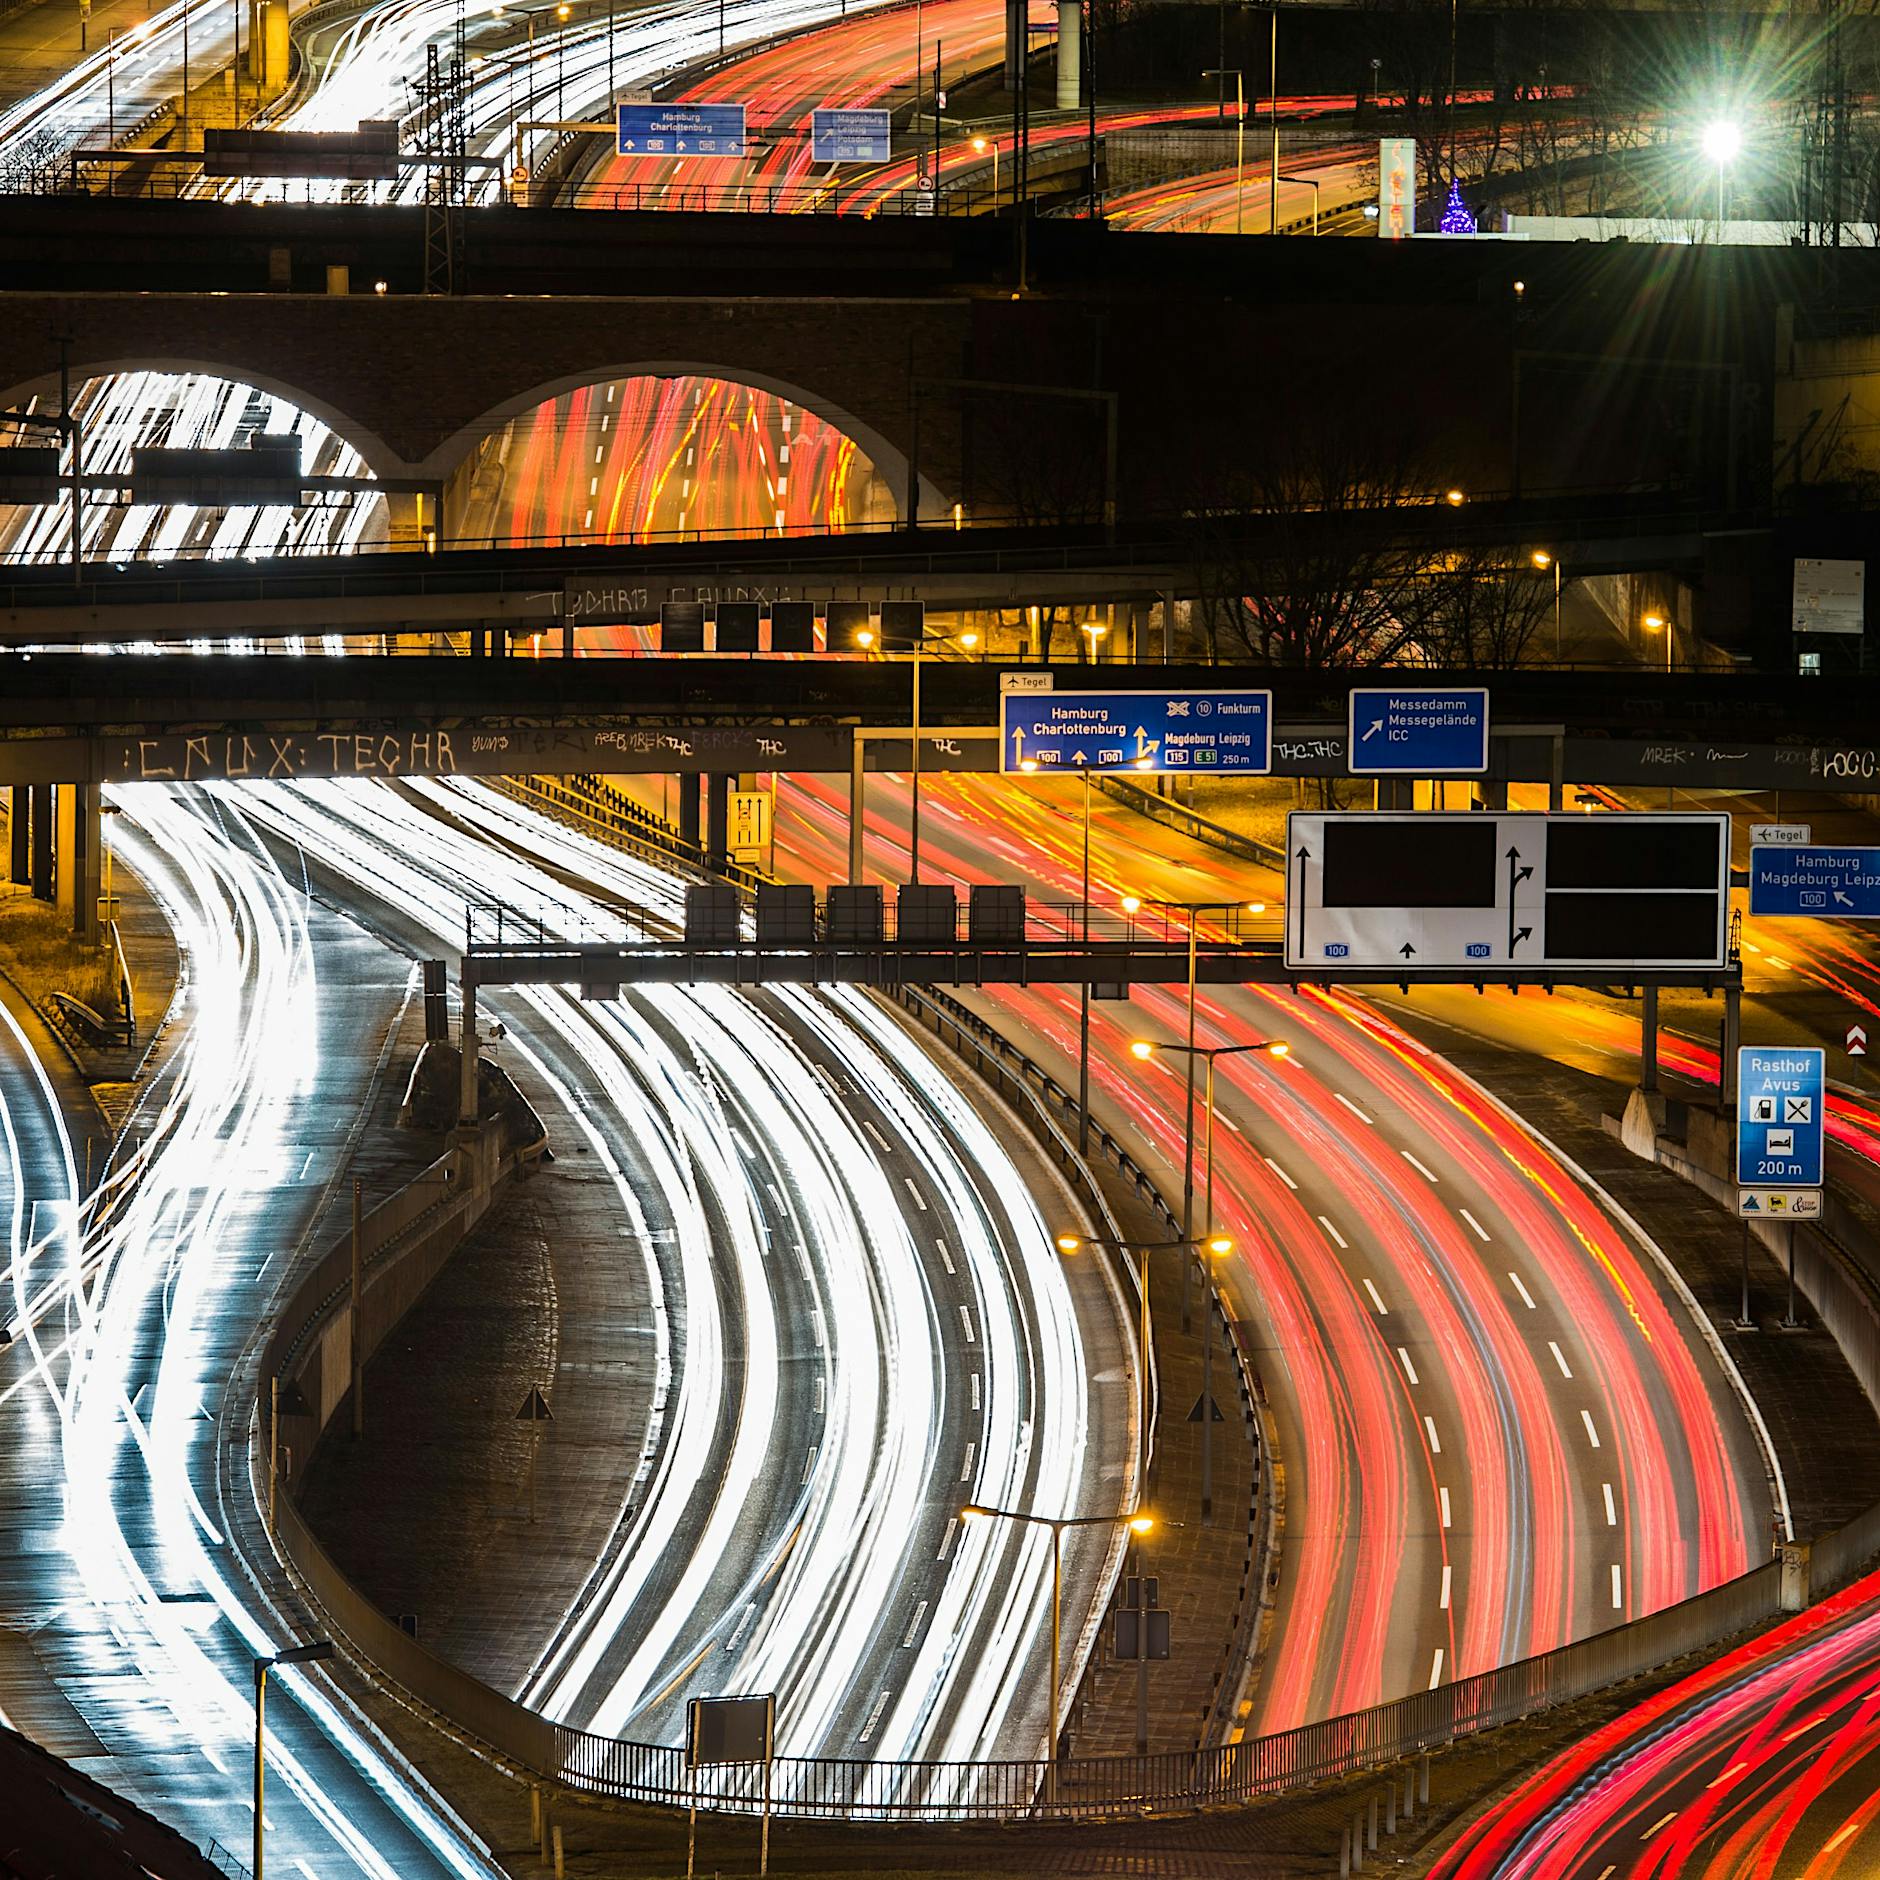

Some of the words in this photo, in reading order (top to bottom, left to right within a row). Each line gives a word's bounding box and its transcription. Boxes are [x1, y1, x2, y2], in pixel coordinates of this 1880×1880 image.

[662, 113, 701, 122] Hamburg
[837, 114, 883, 124] Magdeburg
[650, 123, 713, 133] Charlottenburg
[837, 125, 867, 134] Leipzig
[1022, 678, 1047, 689] Tegel
[1199, 704, 1209, 714] 10
[1217, 703, 1261, 714] Funkturm
[1389, 699, 1467, 710] Messedamm
[1051, 708, 1108, 721] Hamburg
[1389, 714, 1477, 728] Messegelände
[1033, 723, 1127, 737] Charlottenburg
[1388, 730, 1409, 741] ICC
[1165, 733, 1216, 746] Magdeburg
[1219, 733, 1251, 747] Leipzig
[1102, 752, 1118, 762] 100
[1169, 752, 1184, 762] 115
[1222, 755, 1239, 764] 250
[1774, 830, 1803, 842] Tegel
[1796, 855, 1860, 870] Hamburg
[1761, 872, 1839, 887] Magdeburg
[1804, 895, 1822, 904] 100
[1328, 946, 1345, 956] 100
[1470, 946, 1487, 956] 100
[1752, 1058, 1811, 1073] Rasthof
[1762, 1078, 1801, 1091] Avus
[1758, 1161, 1785, 1175] 200
[1788, 1164, 1802, 1175] m
